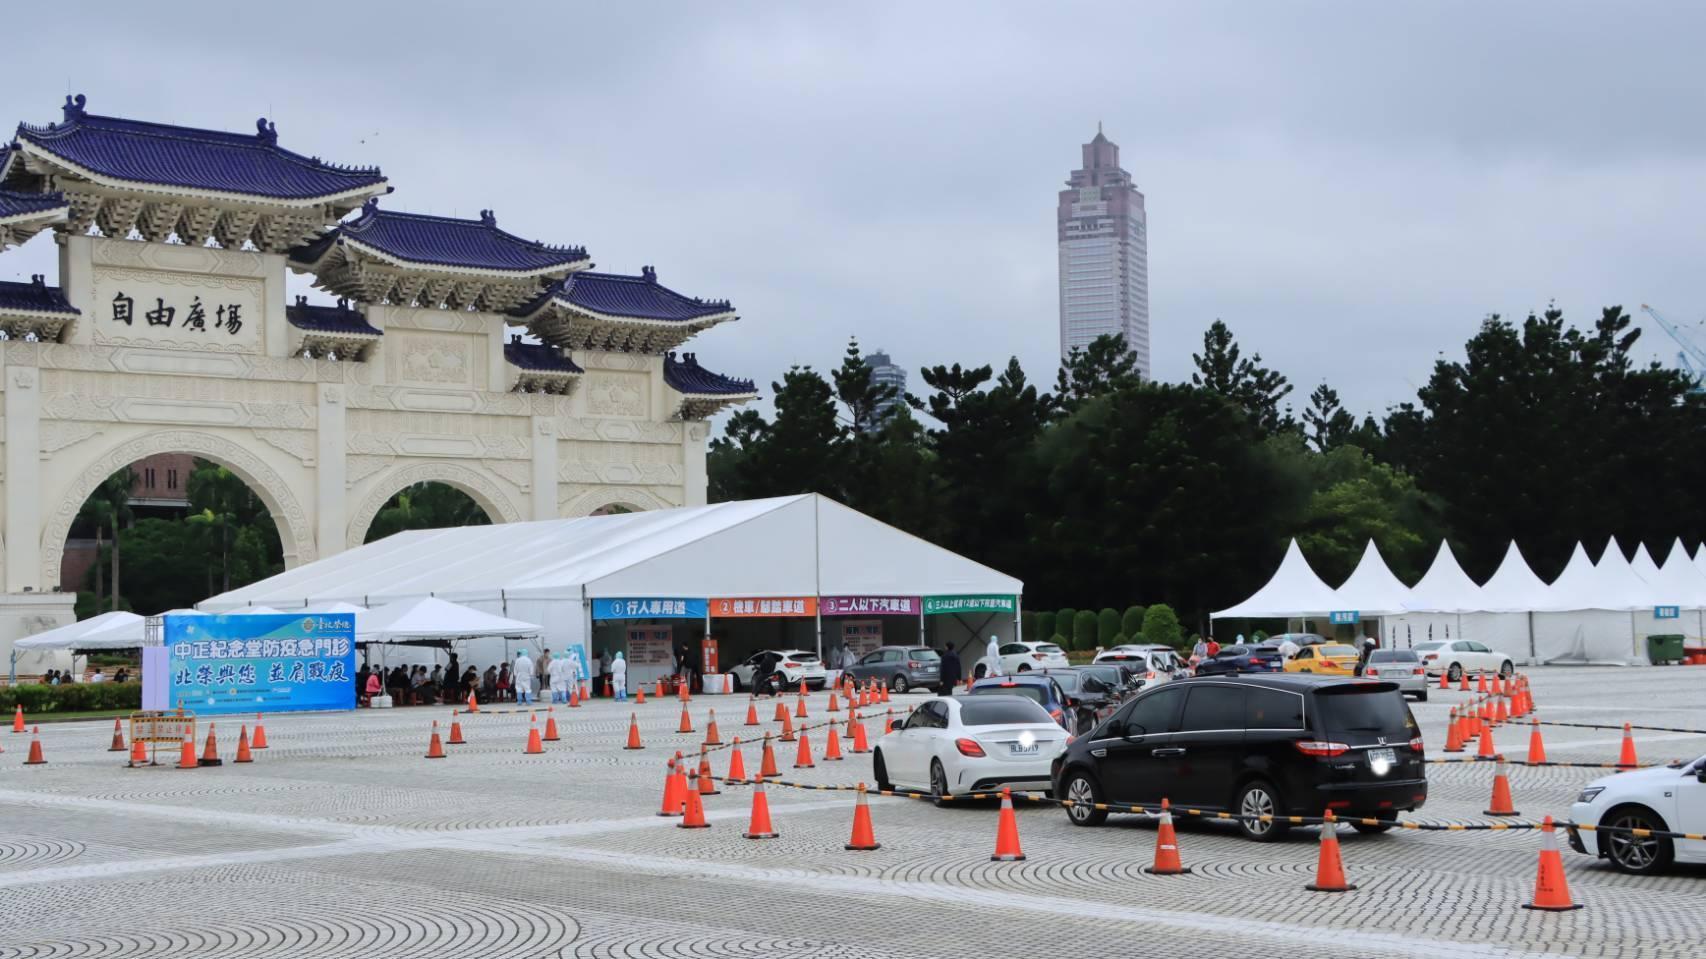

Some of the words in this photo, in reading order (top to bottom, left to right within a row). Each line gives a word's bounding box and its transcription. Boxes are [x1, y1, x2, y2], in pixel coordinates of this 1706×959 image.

[112, 291, 243, 335] 自由廣場
[626, 600, 686, 615] 行人專用道
[839, 599, 912, 612] 二人以下汽車道
[174, 638, 350, 660] 中正紀念堂防疫急門診
[175, 663, 256, 686] 北榮與您
[268, 660, 349, 684] 並肩戰疫
